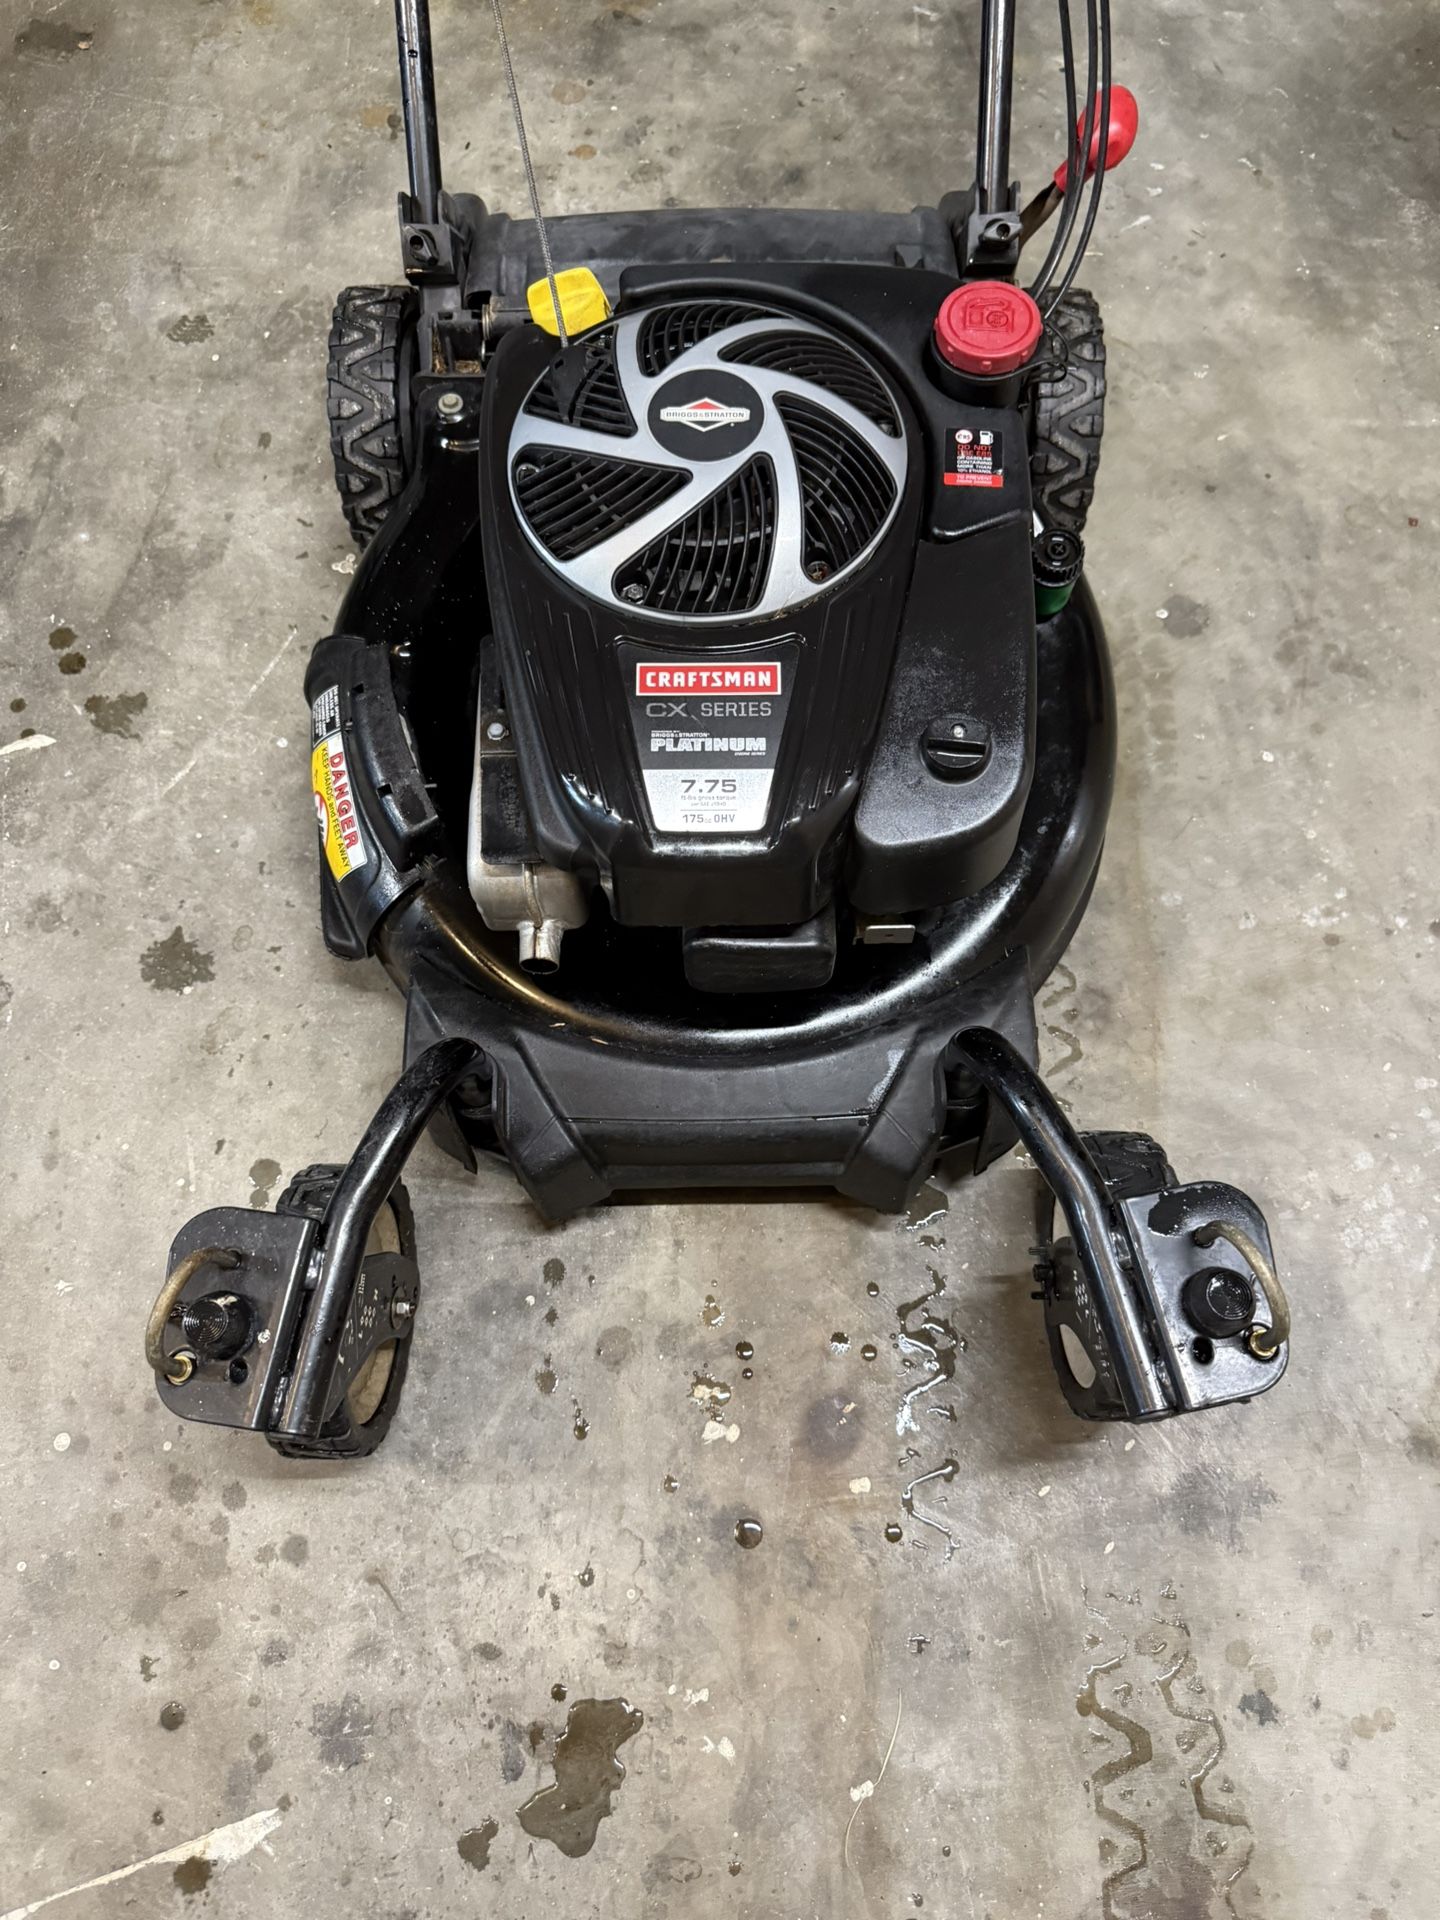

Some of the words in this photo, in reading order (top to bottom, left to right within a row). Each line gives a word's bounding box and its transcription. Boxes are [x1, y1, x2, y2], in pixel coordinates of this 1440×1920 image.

[645, 671, 772, 688] CRAFTSMAN
[646, 702, 688, 717] CX
[700, 702, 772, 717] SERIES
[650, 737, 767, 752] PLATINUM
[321, 747, 330, 768] KEEP
[324, 770, 334, 801] HANDS
[681, 779, 737, 793] 7.75
[328, 801, 337, 817] and
[329, 751, 359, 850] DANGER
[713, 814, 736, 823] OHV
[332, 816, 343, 840] FEET
[337, 839, 350, 868] AWAY
